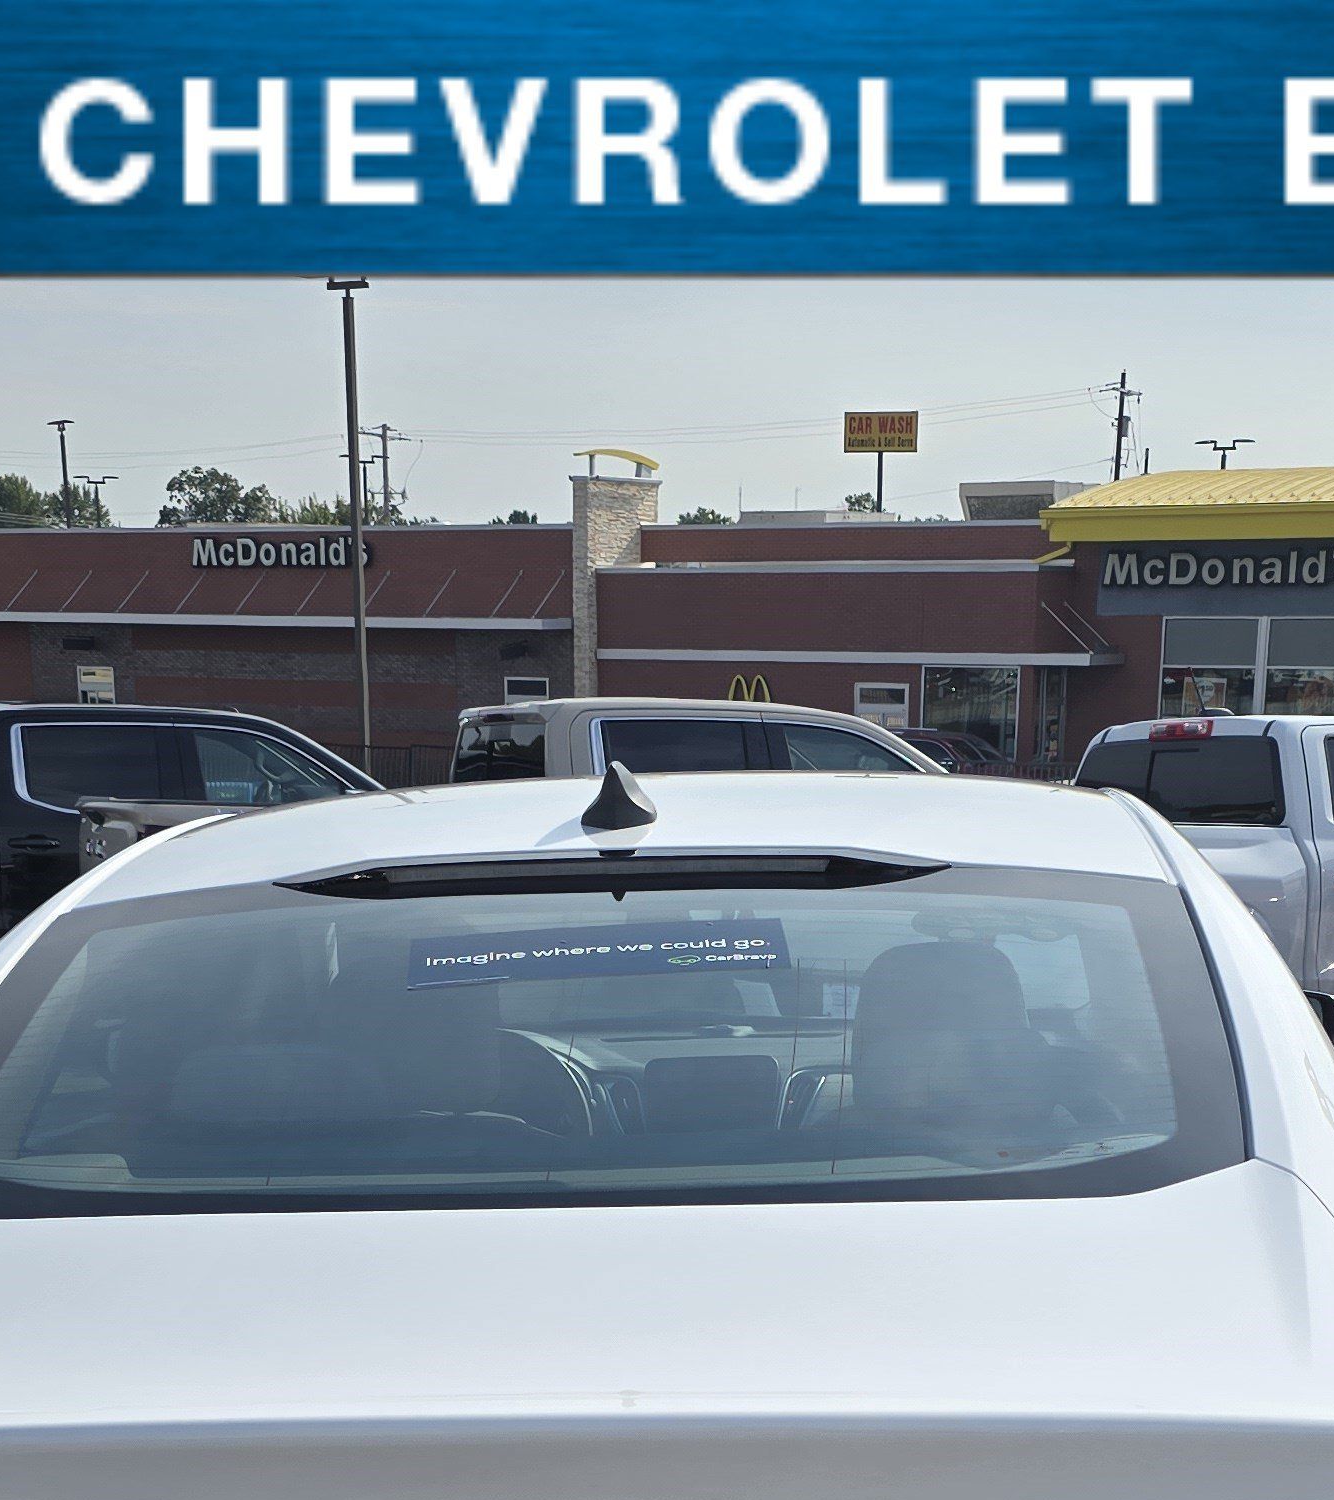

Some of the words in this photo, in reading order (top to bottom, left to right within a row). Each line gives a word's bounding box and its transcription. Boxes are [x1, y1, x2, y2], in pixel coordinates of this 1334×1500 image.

[849, 416, 873, 435] CAR
[877, 415, 913, 435] WASH
[425, 951, 526, 967] Imagine
[532, 945, 611, 958] where
[617, 942, 654, 953] we
[660, 938, 727, 952] could
